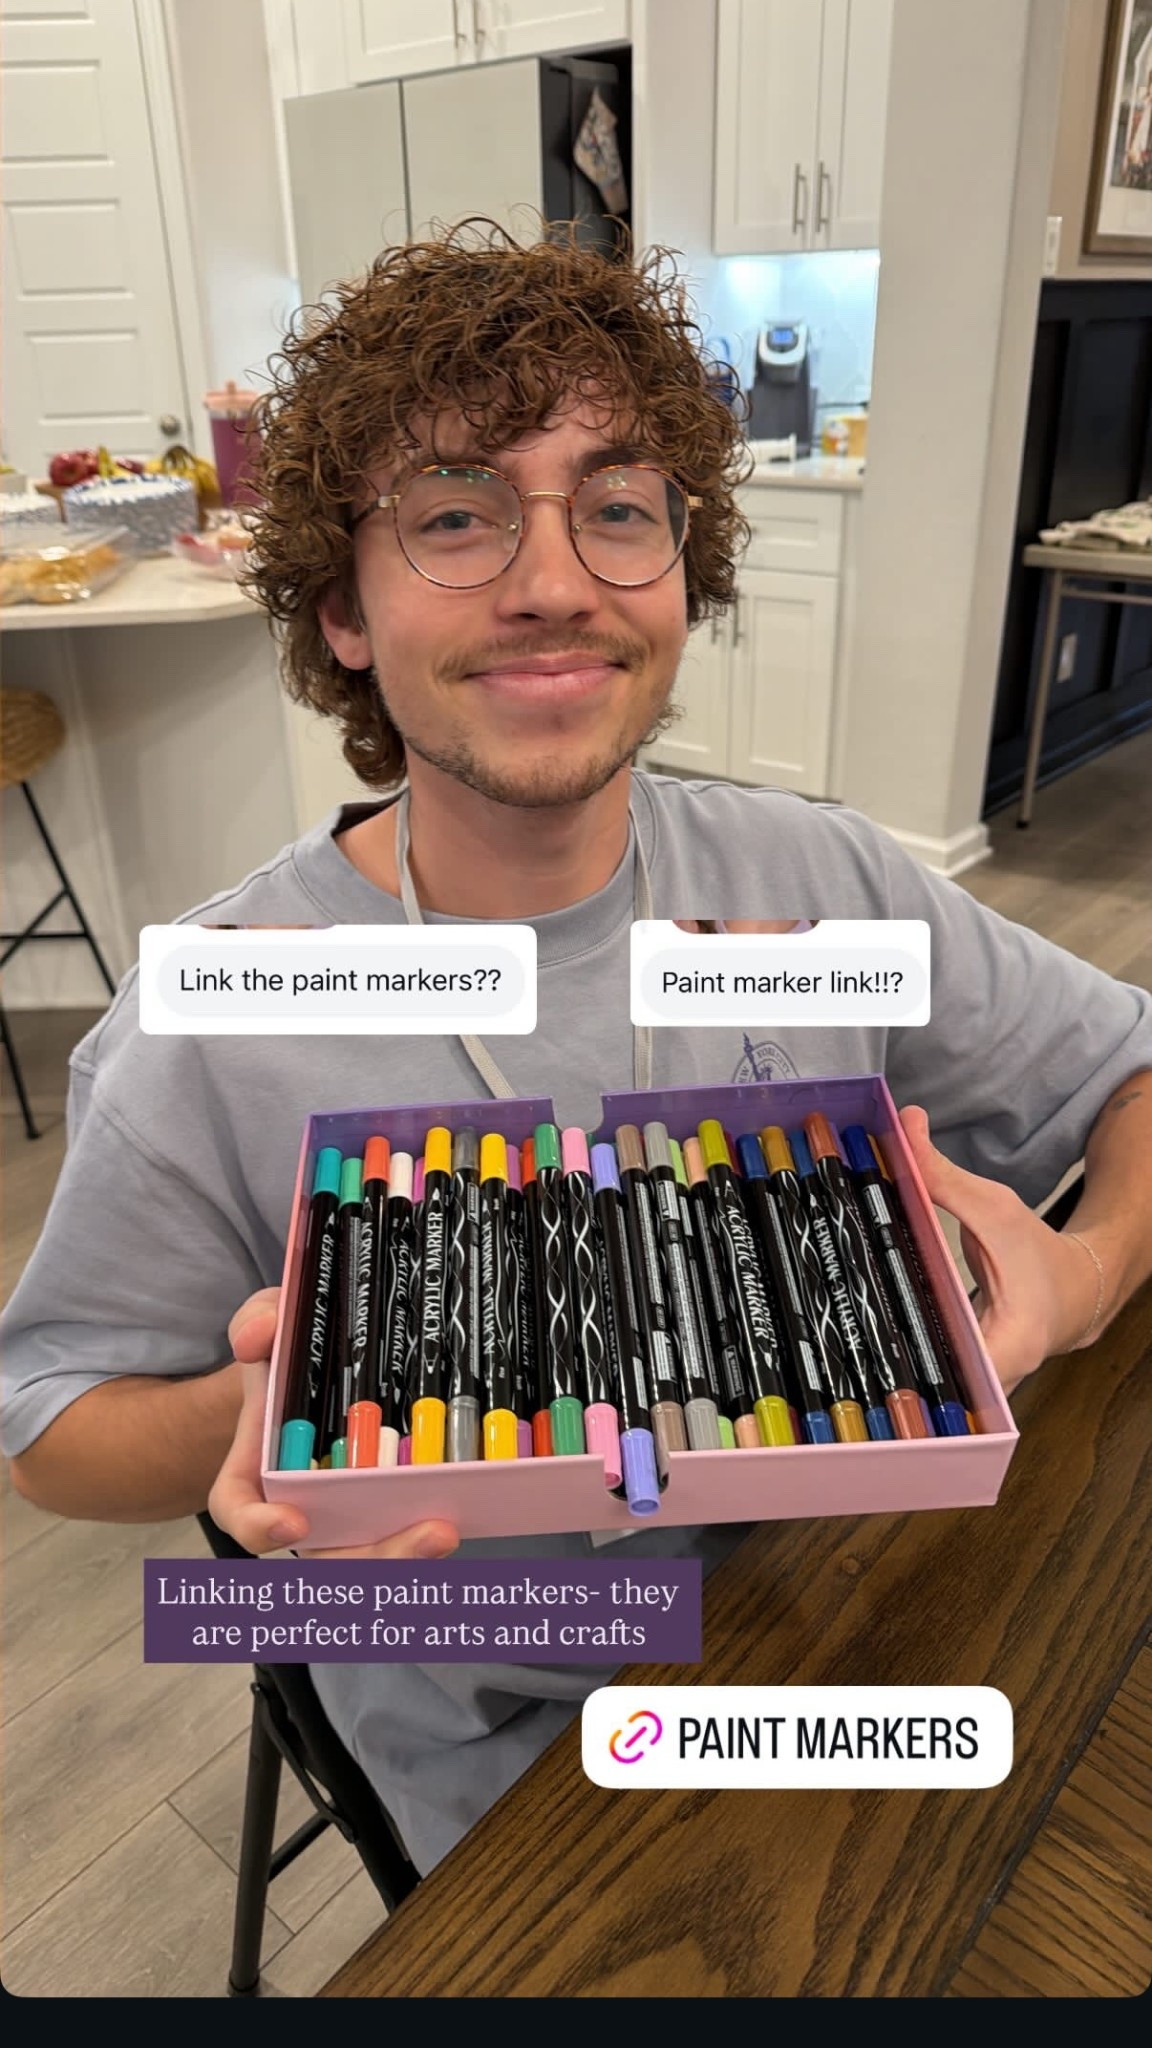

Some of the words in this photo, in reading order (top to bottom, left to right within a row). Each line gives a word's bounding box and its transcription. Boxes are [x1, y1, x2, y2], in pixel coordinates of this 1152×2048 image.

[316, 1233, 335, 1297] MARKER
[425, 1211, 445, 1271] MARKER
[725, 1204, 752, 1267] ACRYLIC
[740, 1271, 771, 1339] MARKER
[812, 1216, 842, 1281] MARKER
[310, 1297, 329, 1370] ACRYLIC
[422, 1274, 442, 1344] ACRYLIC
[830, 1280, 864, 1350] ACRYLIC
